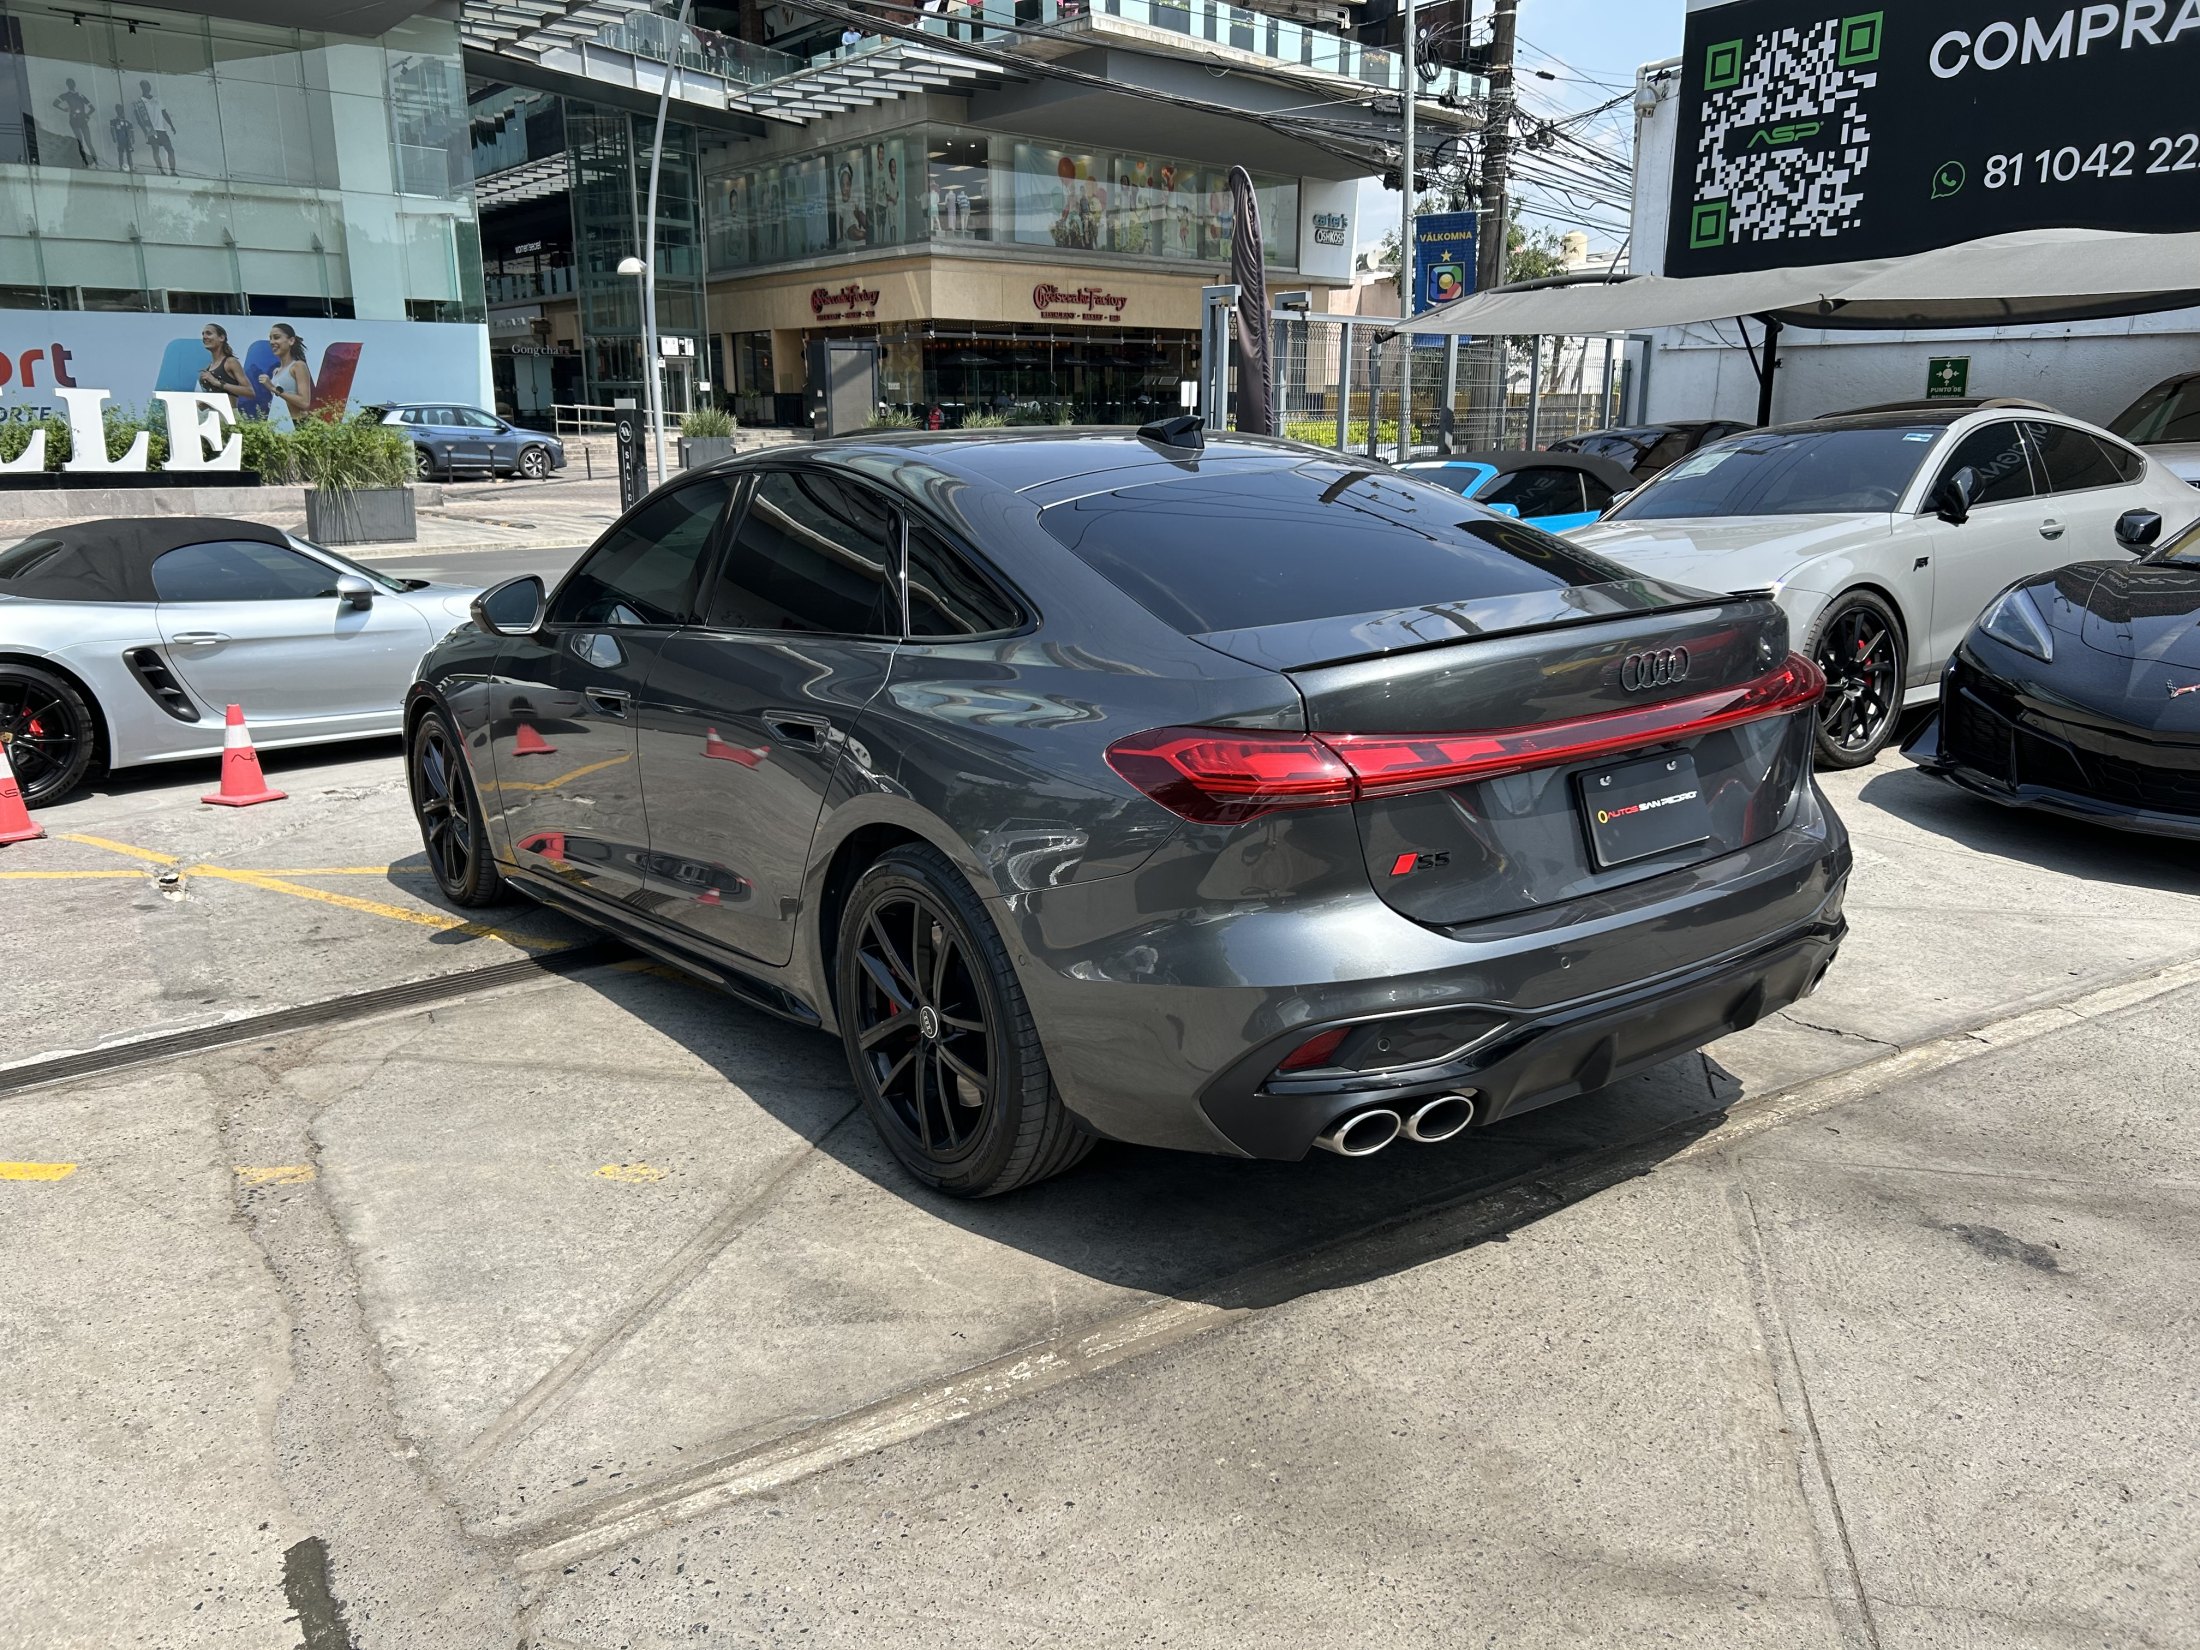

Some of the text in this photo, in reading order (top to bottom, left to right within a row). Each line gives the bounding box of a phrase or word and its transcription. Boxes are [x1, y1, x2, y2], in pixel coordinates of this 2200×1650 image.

[1746, 121, 1820, 149] ASP
[1983, 133, 2200, 189] 81 1042 22
[1420, 231, 1473, 243] VÄLKOMNA
[1084, 287, 1128, 312] Factory
[511, 344, 540, 357] Gong
[541, 344, 560, 355] cha
[1607, 805, 1639, 819] AUTOS
[1638, 800, 1662, 811] SAN
[1417, 851, 1450, 870] S5
